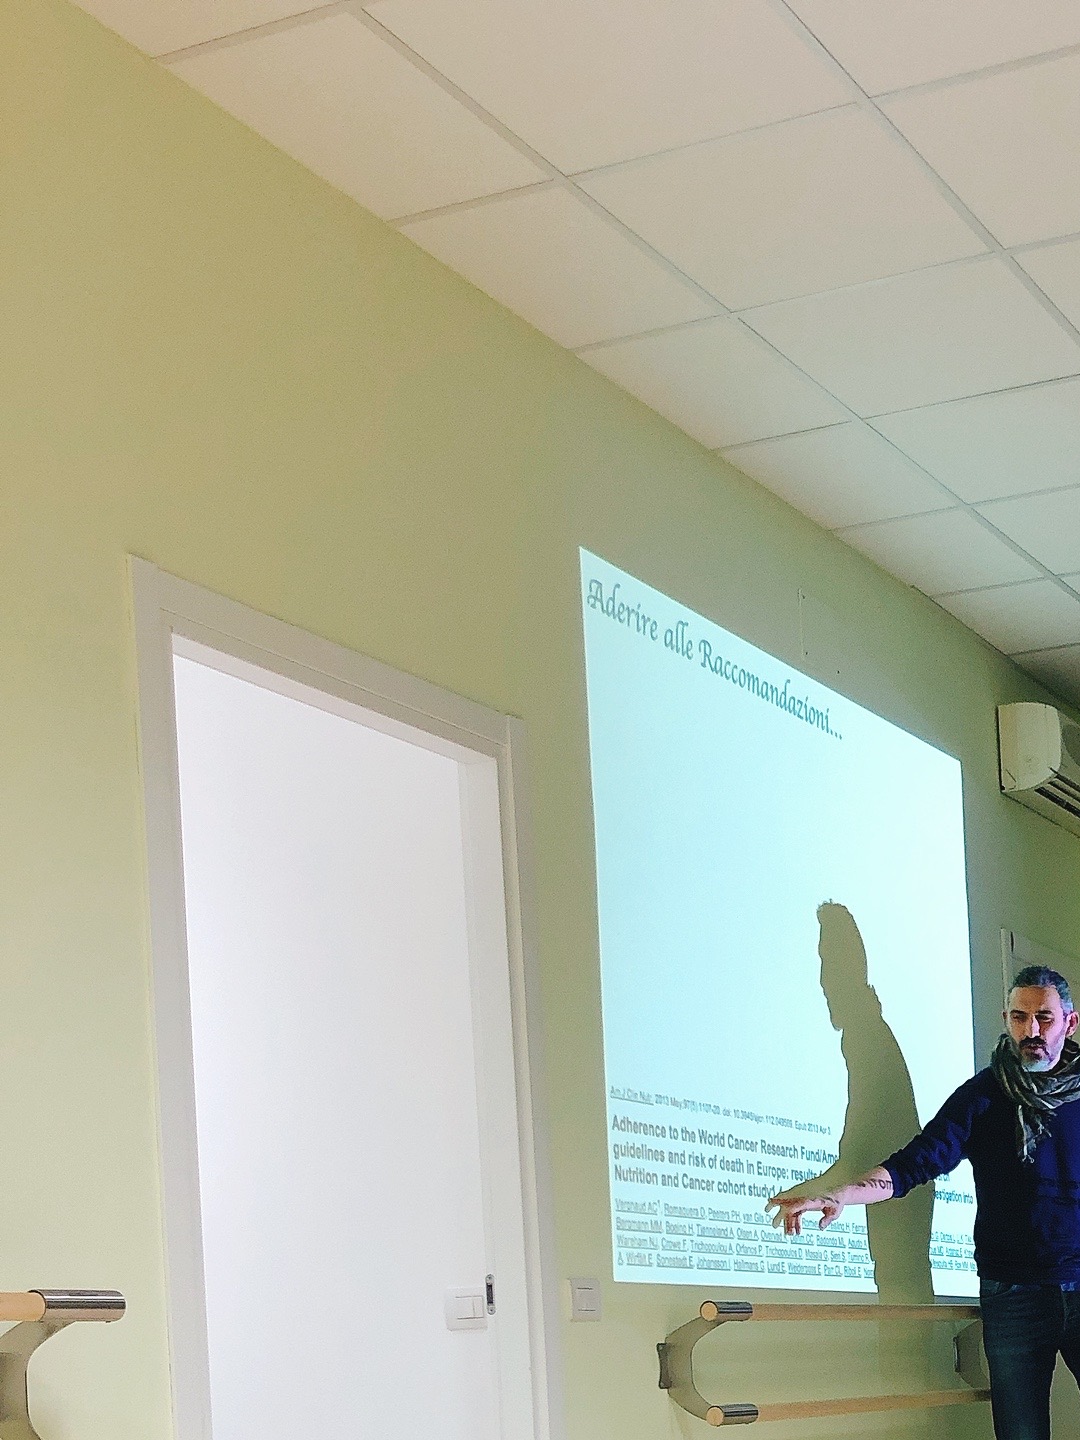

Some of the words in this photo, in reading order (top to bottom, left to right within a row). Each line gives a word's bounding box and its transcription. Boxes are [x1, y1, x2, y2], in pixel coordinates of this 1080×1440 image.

[587, 578, 658, 642] Aderire
[664, 620, 694, 661] alle
[699, 638, 843, 741] Raccomandazioni...
[612, 1114, 666, 1138] Adherence
[669, 1125, 679, 1140] to
[681, 1126, 696, 1143] the
[698, 1128, 726, 1148] World
[728, 1134, 758, 1153] Cancer
[760, 1139, 799, 1160] Research
[613, 1141, 665, 1163] guidelines
[668, 1150, 686, 1166] and
[688, 1150, 706, 1168] risk
[708, 1154, 717, 1170] of
[720, 1156, 744, 1174] death
[746, 1159, 754, 1175] in
[756, 1160, 789, 1180] Europe:
[614, 1164, 658, 1186] Nutrition
[661, 1172, 680, 1188] and
[682, 1173, 715, 1192] Cancer
[717, 1178, 746, 1196] cohort
